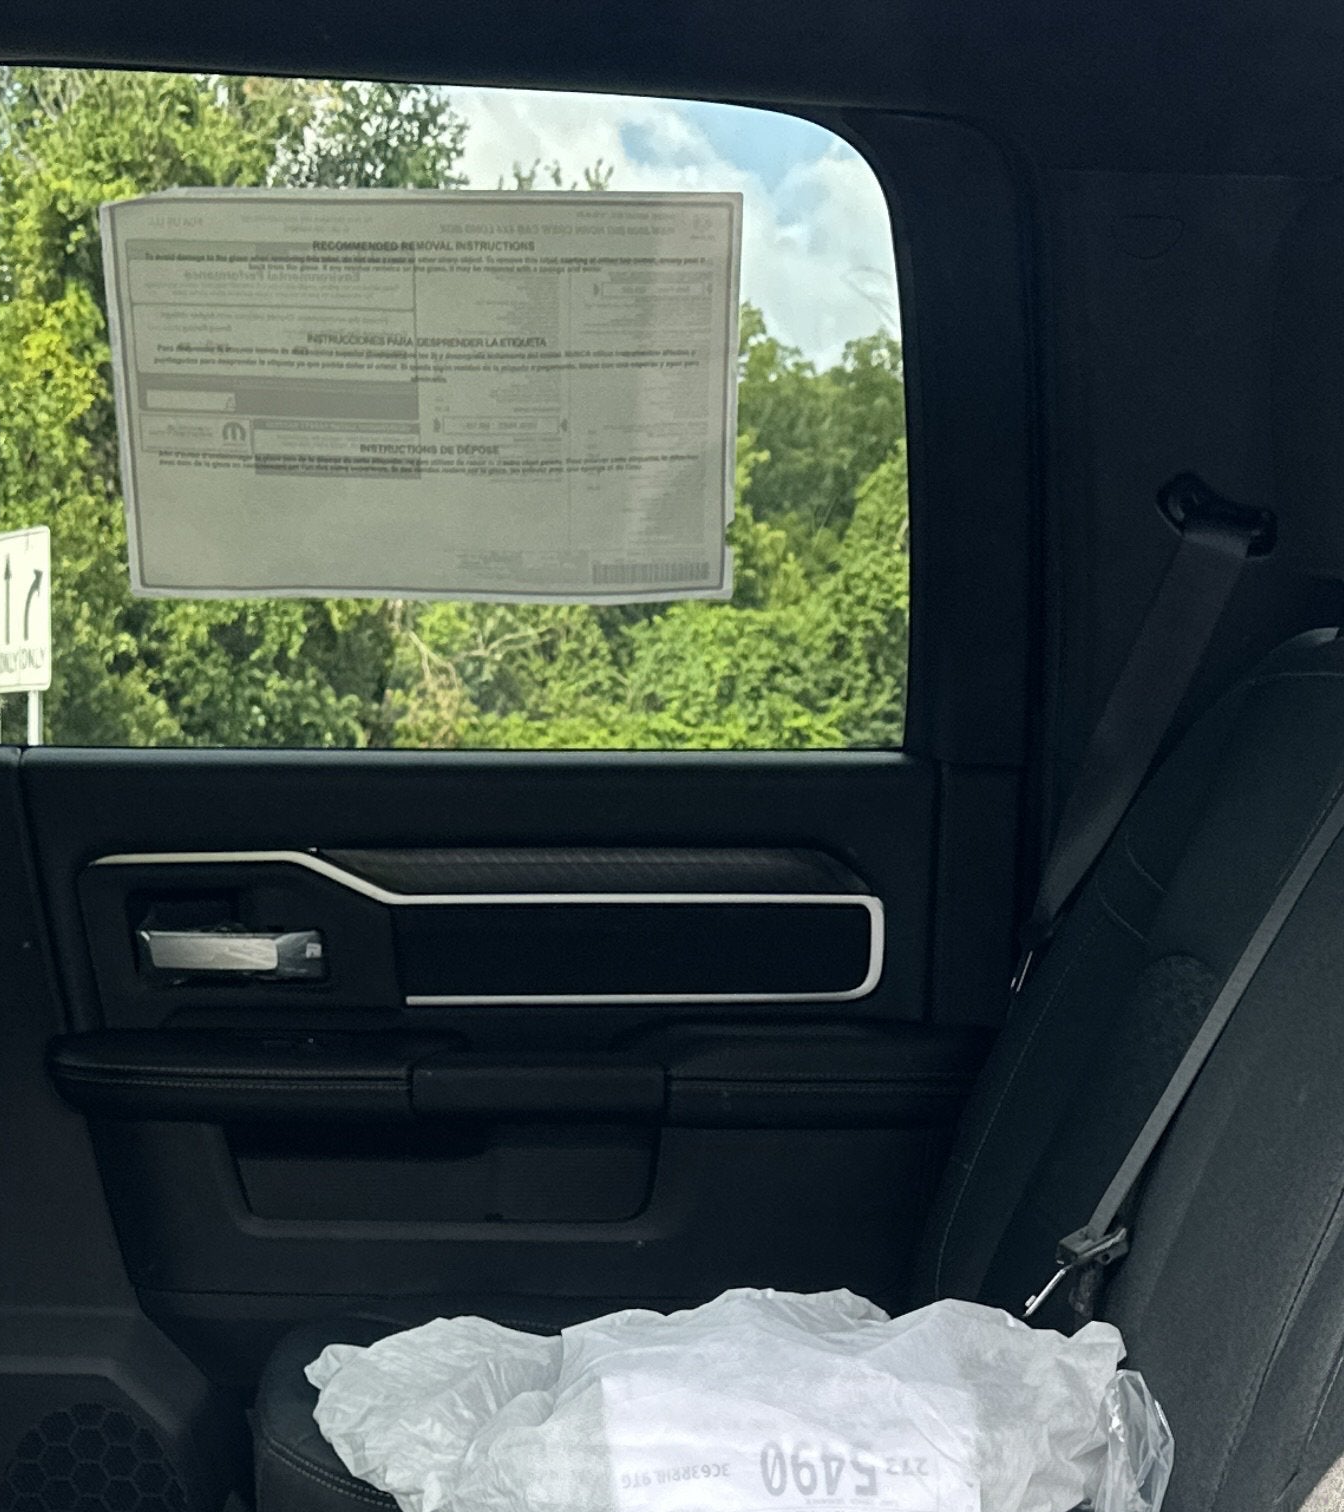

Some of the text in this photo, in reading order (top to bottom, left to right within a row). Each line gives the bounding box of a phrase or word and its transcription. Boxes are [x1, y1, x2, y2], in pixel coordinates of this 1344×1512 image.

[312, 240, 535, 252] RECOMMENDED REMOVAL INSTRUCTIONS
[306, 333, 546, 348] INSTRUCCIONES PARA DESPRENDER LA ETIQUETA
[359, 443, 500, 455] INSTRUCTIONS DE DÉPOSE
[19, 647, 46, 670] ONLY
[761, 1441, 878, 1497] 5490
